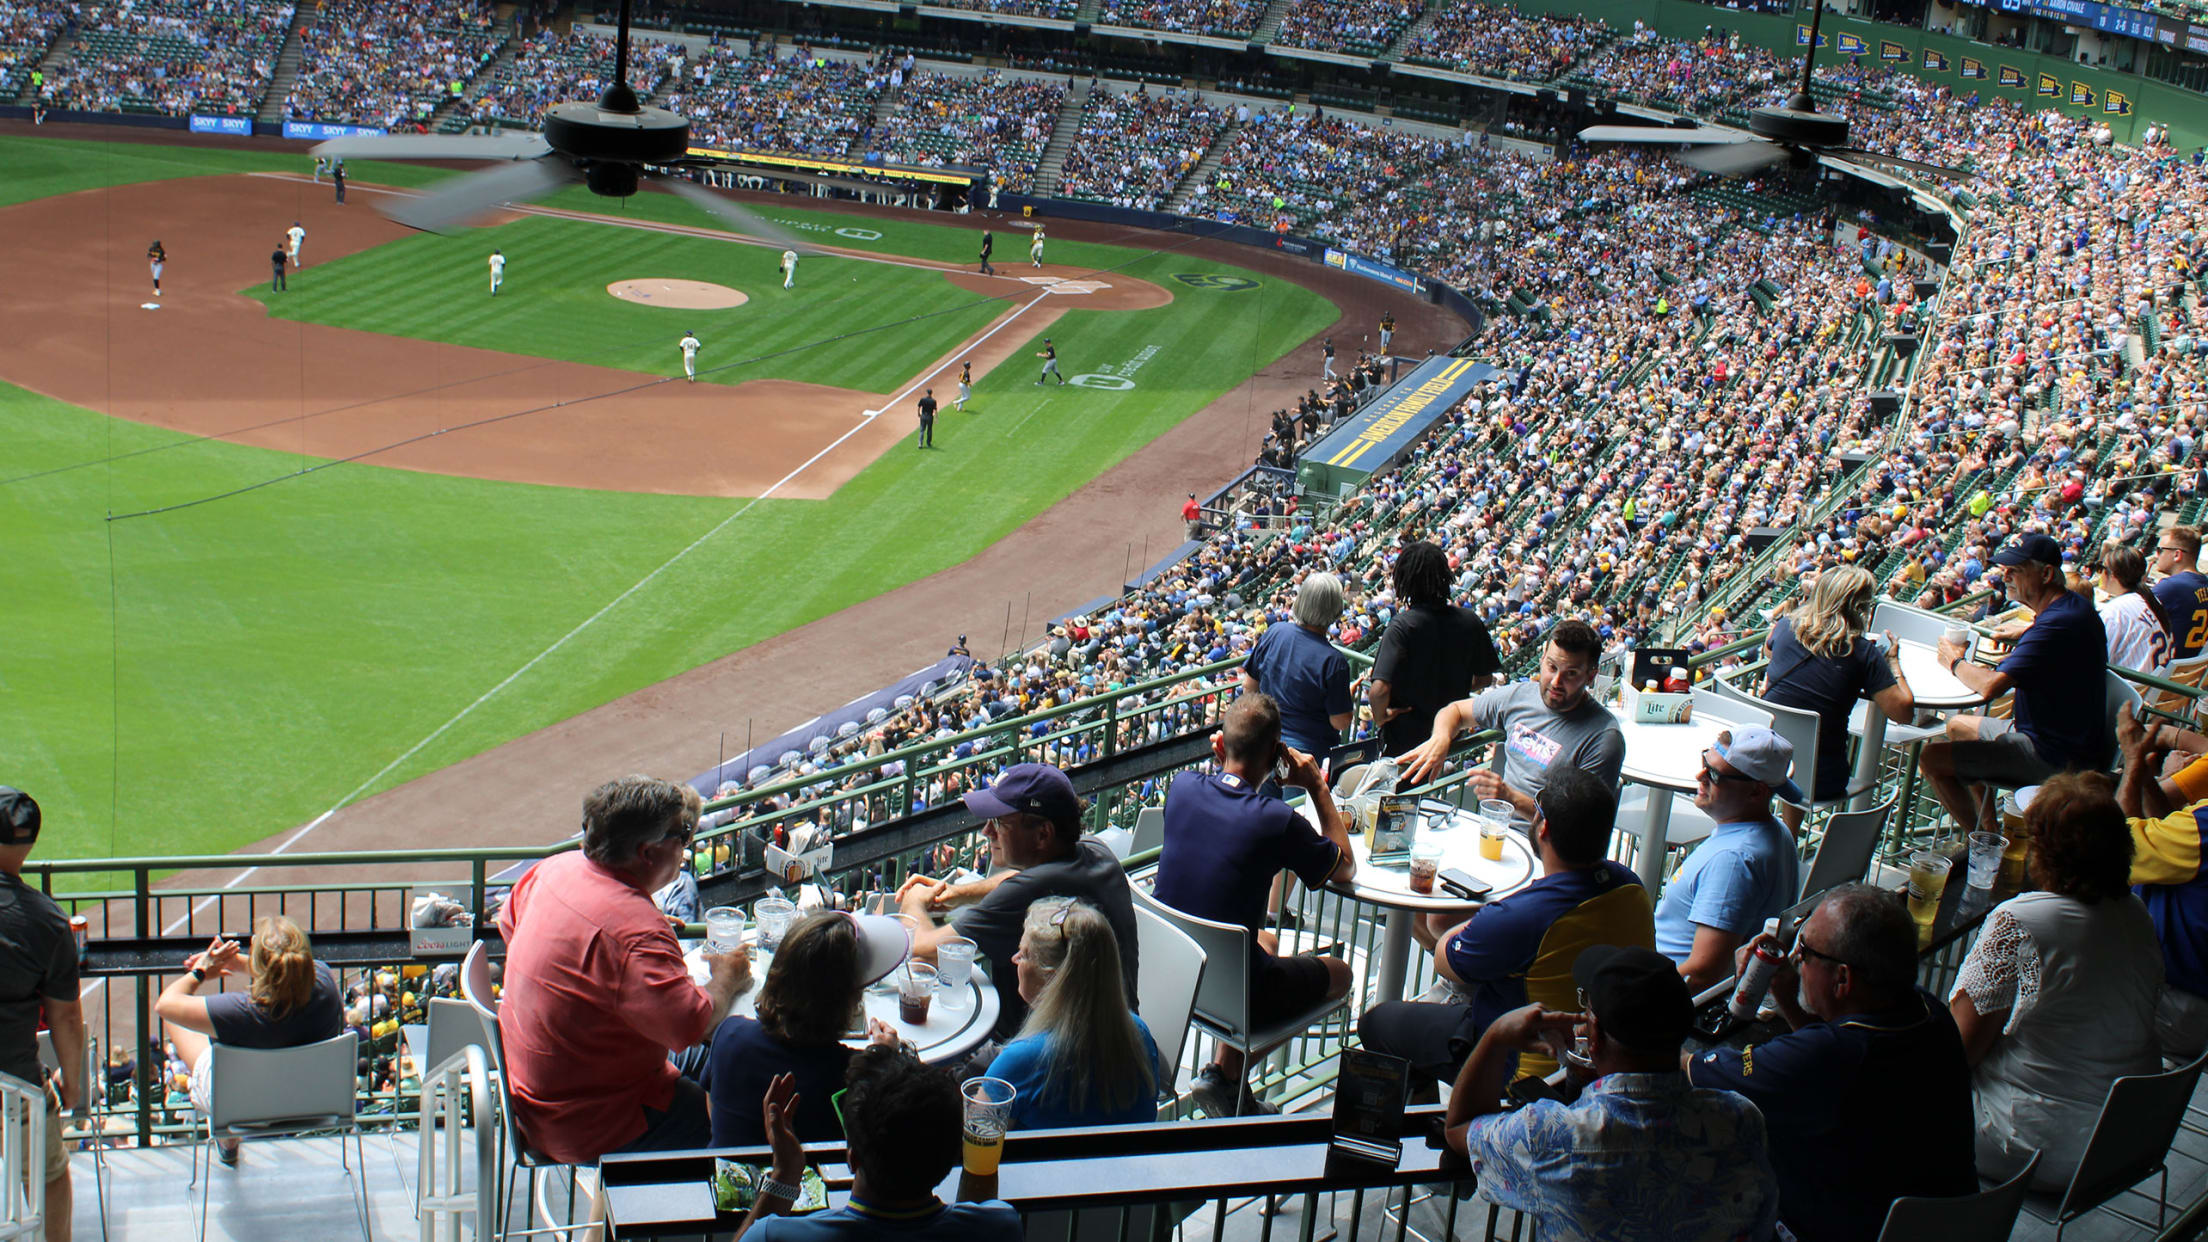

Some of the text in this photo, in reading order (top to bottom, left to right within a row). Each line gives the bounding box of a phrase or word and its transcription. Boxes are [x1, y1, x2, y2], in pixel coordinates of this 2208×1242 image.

[193, 117, 247, 129] SKYY SKYY
[289, 123, 314, 134] SKYY
[322, 126, 347, 136] SKYY
[1358, 378, 1455, 442] AMERICAN FAMILY FIELD
[2184, 608, 2208, 649] 2
[1647, 702, 1665, 715] Lite
[816, 855, 829, 868] Lite
[417, 940, 471, 950] Coors LIGHT
